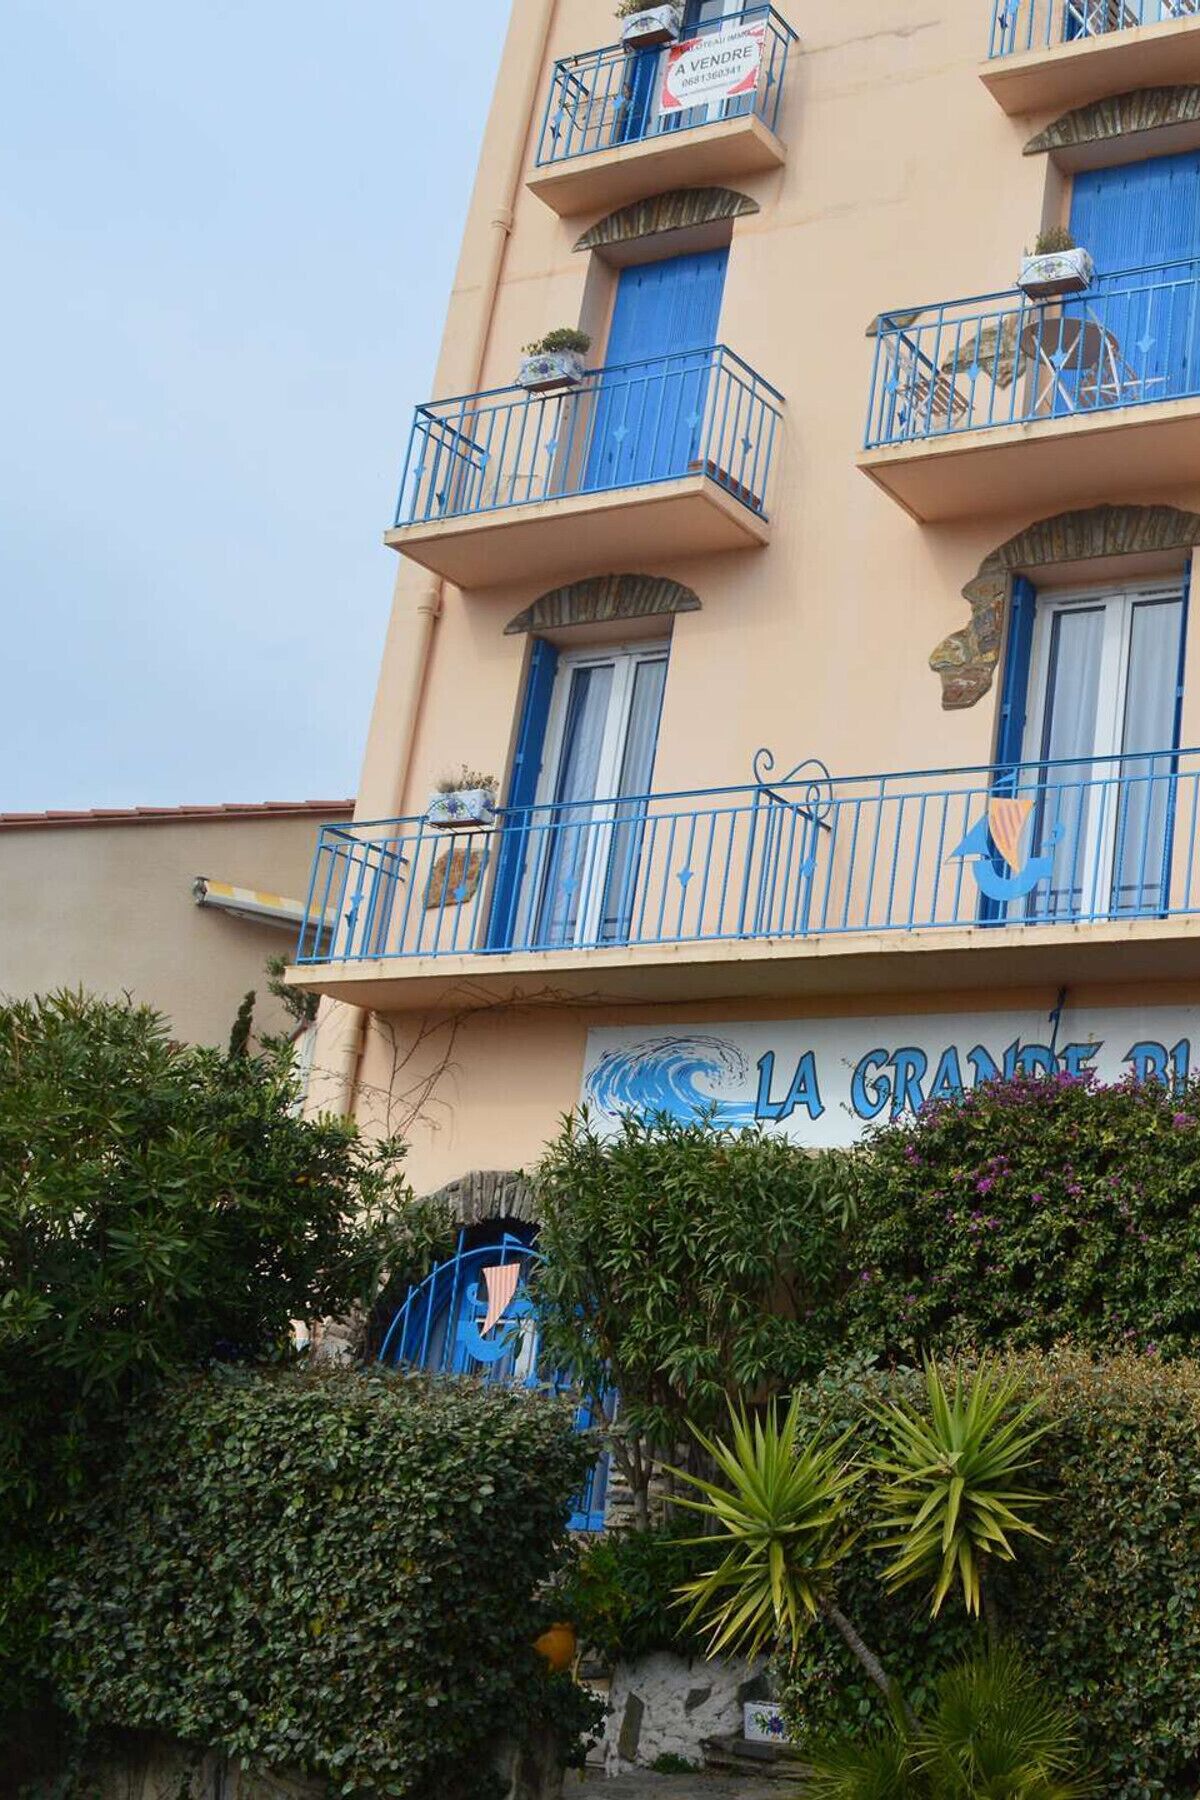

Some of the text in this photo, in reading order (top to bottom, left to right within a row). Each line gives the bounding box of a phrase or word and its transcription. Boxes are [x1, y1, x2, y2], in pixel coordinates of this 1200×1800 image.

[675, 45, 753, 76] A VENDRE
[754, 1050, 826, 1124] LA
